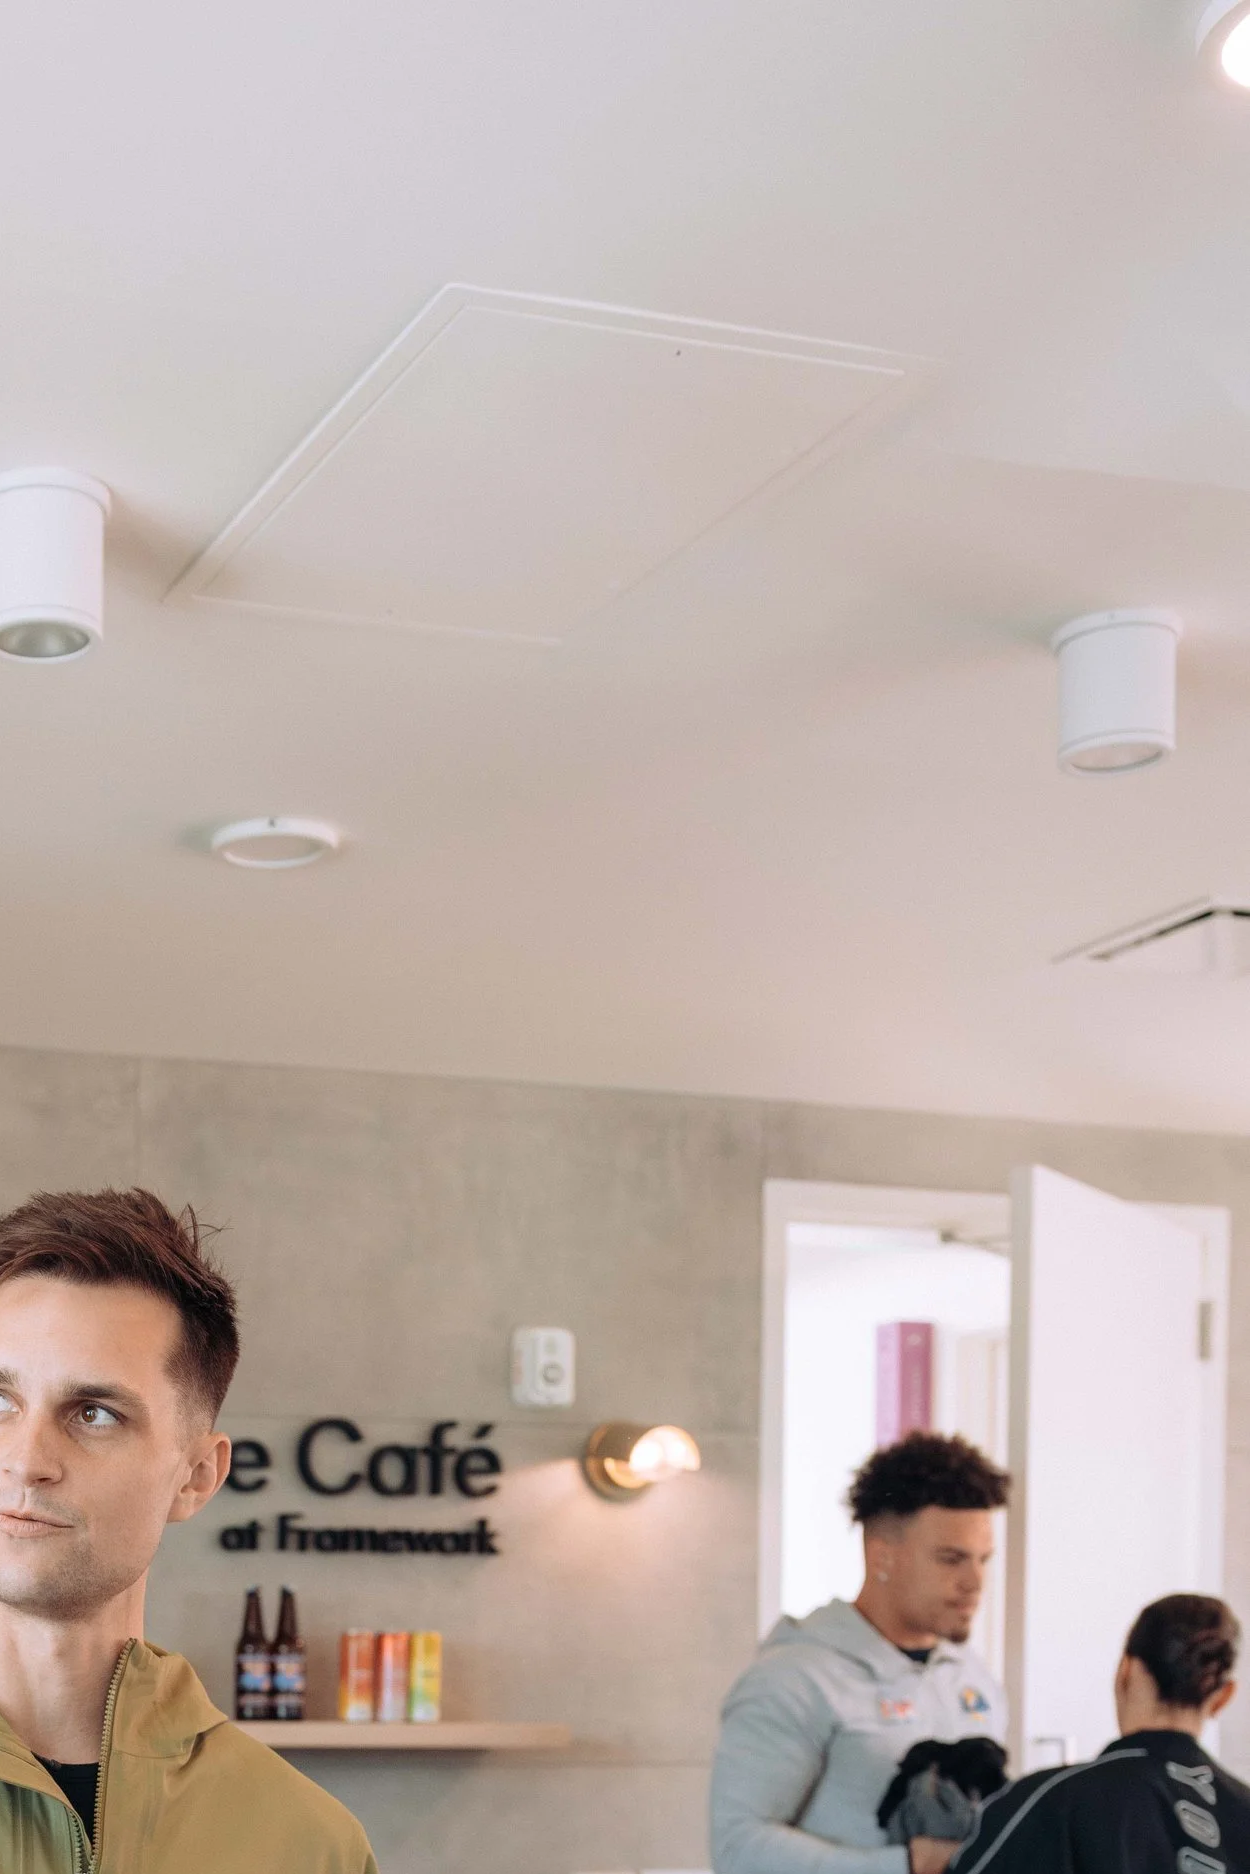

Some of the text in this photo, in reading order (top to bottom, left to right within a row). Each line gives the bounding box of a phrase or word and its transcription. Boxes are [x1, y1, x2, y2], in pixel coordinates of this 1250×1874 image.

[297, 1418, 502, 1498] Café
[219, 1512, 501, 1555] at Framework
